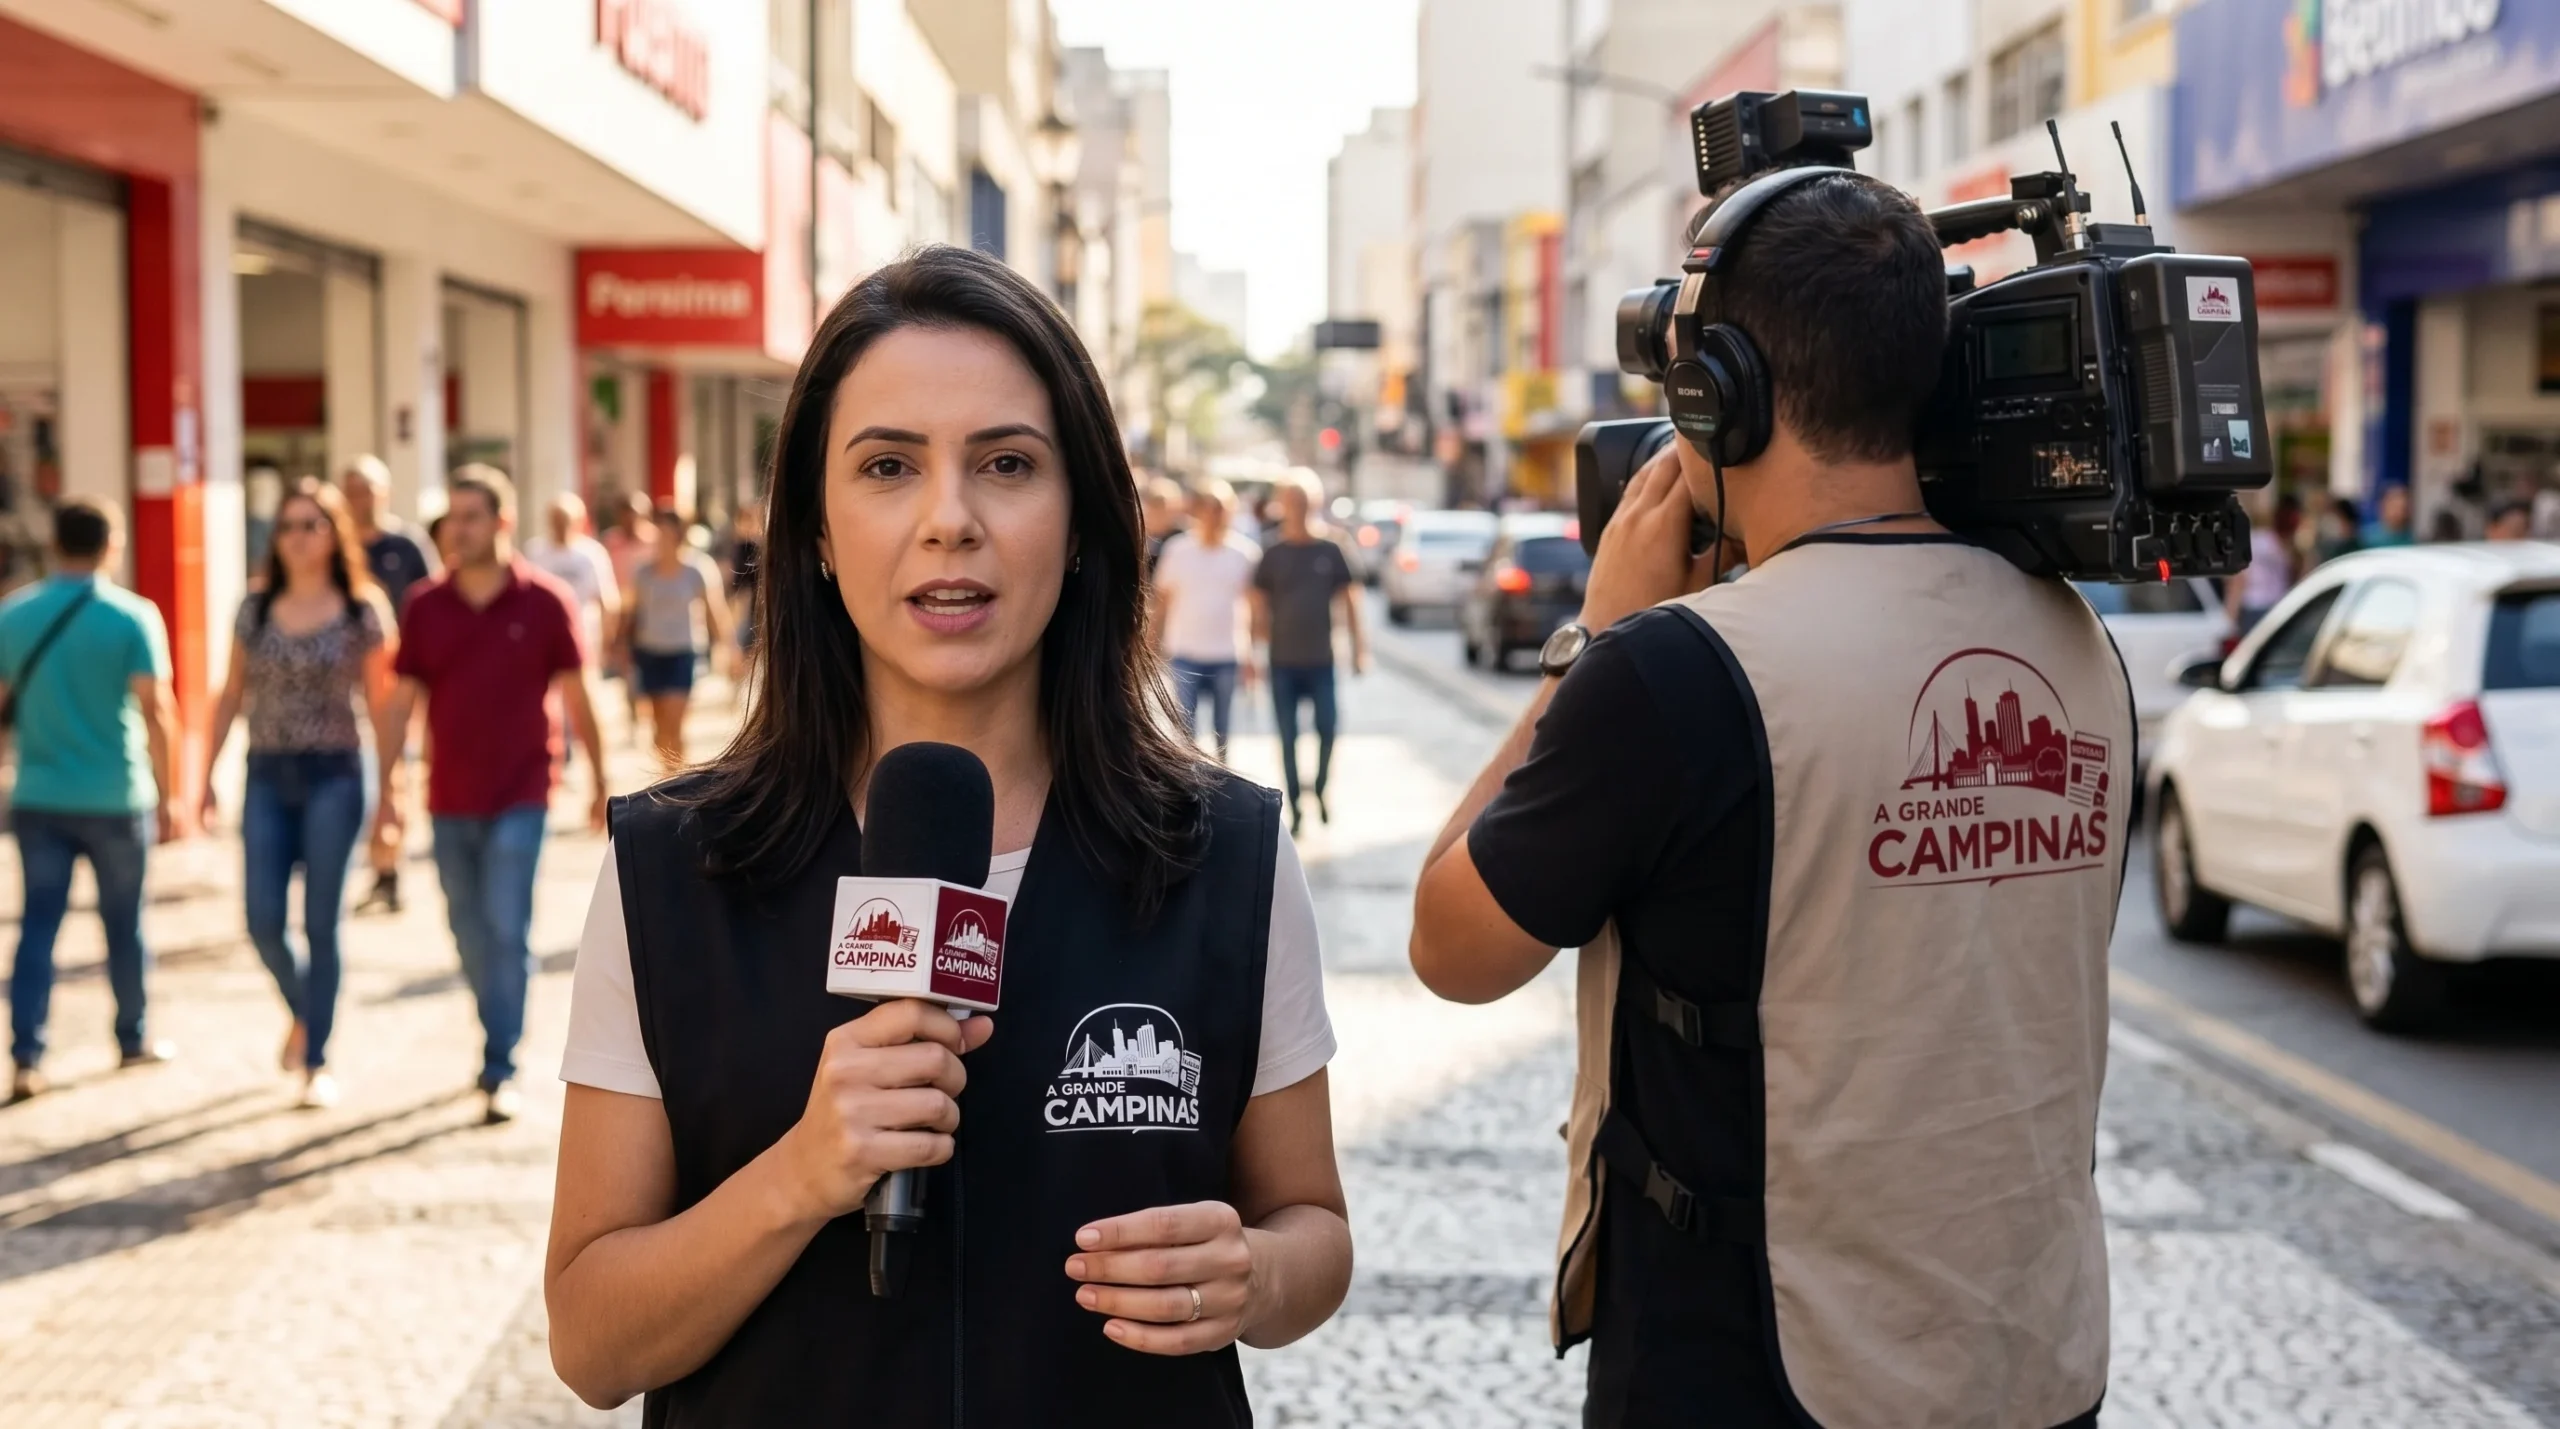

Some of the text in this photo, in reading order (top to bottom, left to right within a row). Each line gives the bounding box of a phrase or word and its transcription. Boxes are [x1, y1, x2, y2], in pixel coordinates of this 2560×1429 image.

[1873, 796, 1985, 824] A GRANDE
[1868, 810, 2108, 878] CAMPINAS
[834, 951, 917, 968] CAMPINAS
[935, 955, 997, 981] CAMPINAS
[1046, 1081, 1126, 1097] A GRANDE
[1044, 1095, 1200, 1126] CAMPINAS
